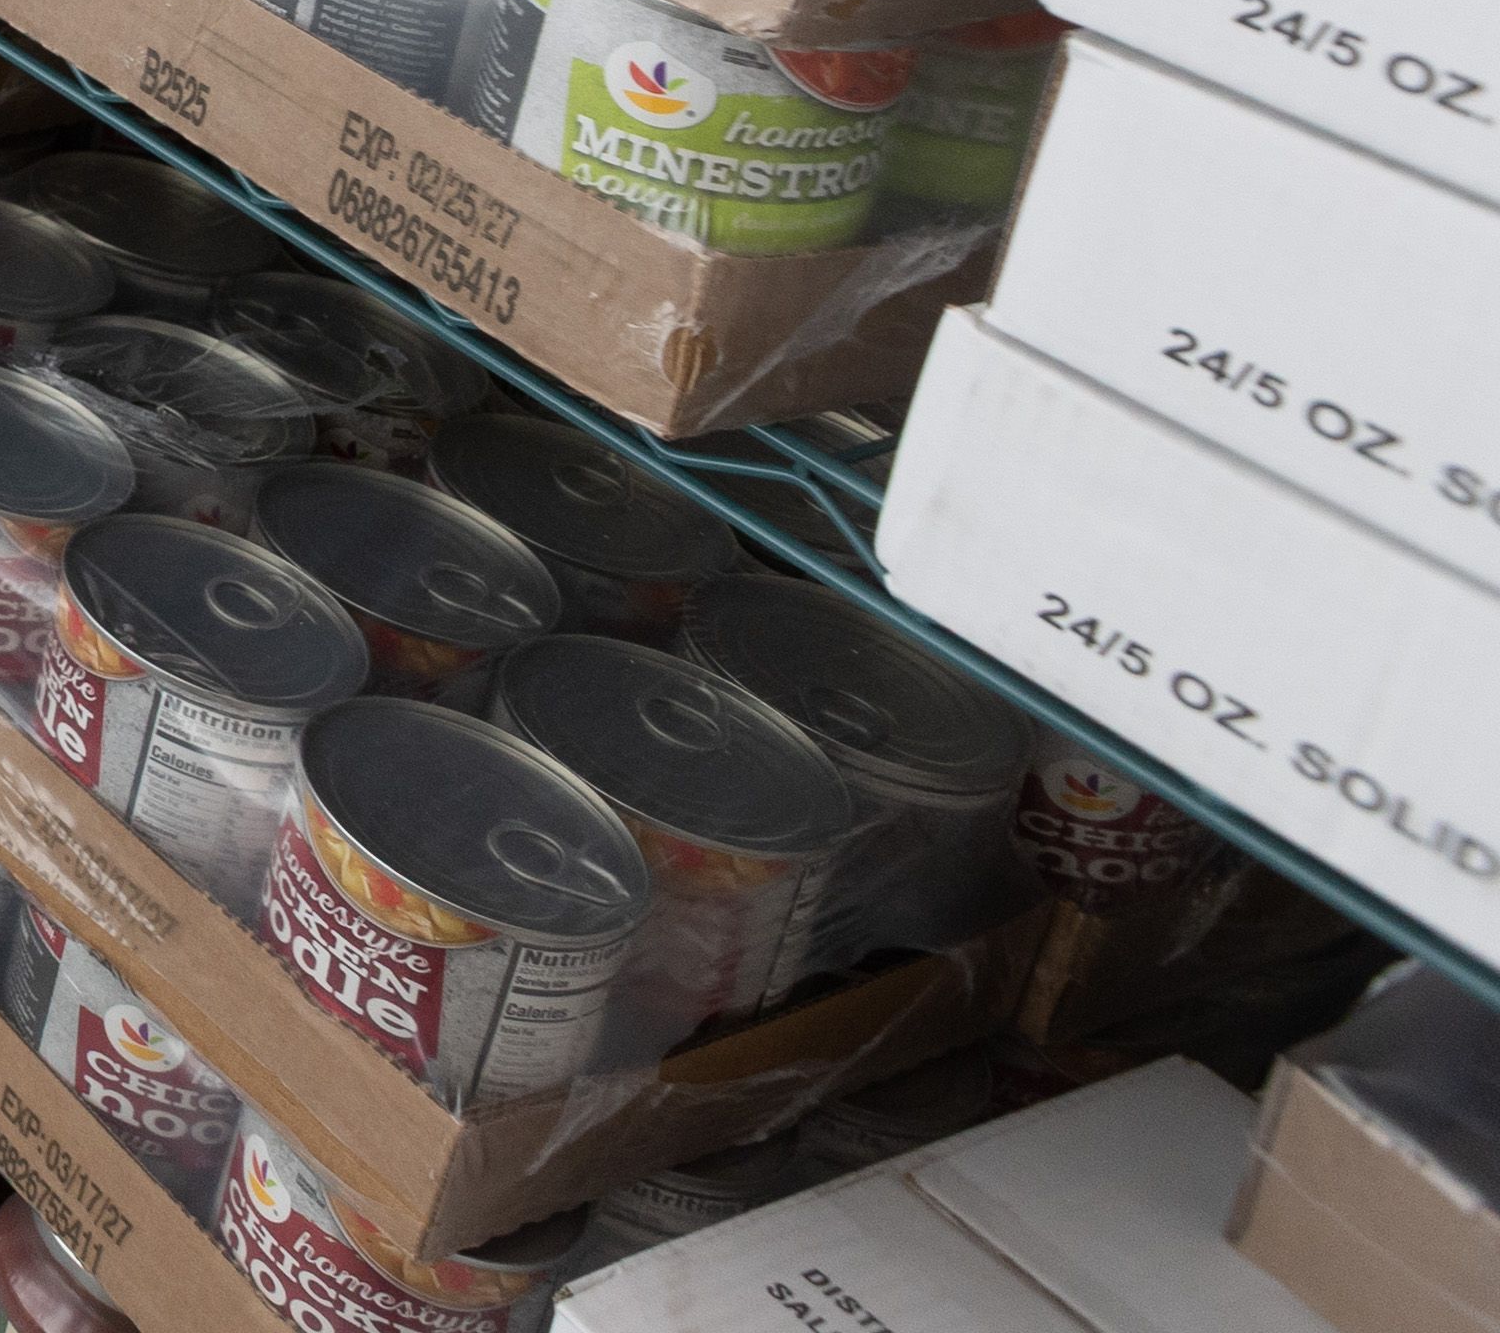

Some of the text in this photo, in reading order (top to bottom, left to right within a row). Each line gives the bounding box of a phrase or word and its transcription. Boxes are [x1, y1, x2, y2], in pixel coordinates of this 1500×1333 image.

[138, 46, 211, 129] B2525
[339, 109, 521, 251] EXP: 02/25/27
[326, 168, 522, 327] 068826755413
[1161, 326, 1290, 411] 24/5
[150, 744, 215, 782] Calories
[164, 693, 283, 743] Nutrition
[1036, 591, 1155, 680] 24/5
[1289, 739, 1500, 883] SOLID
[262, 867, 418, 1038] oodle
[281, 830, 431, 974] homestyle
[503, 1000, 569, 1022] Calories
[0, 1084, 135, 1249] EXP: 03/17/27
[802, 1269, 894, 1333] DIST
